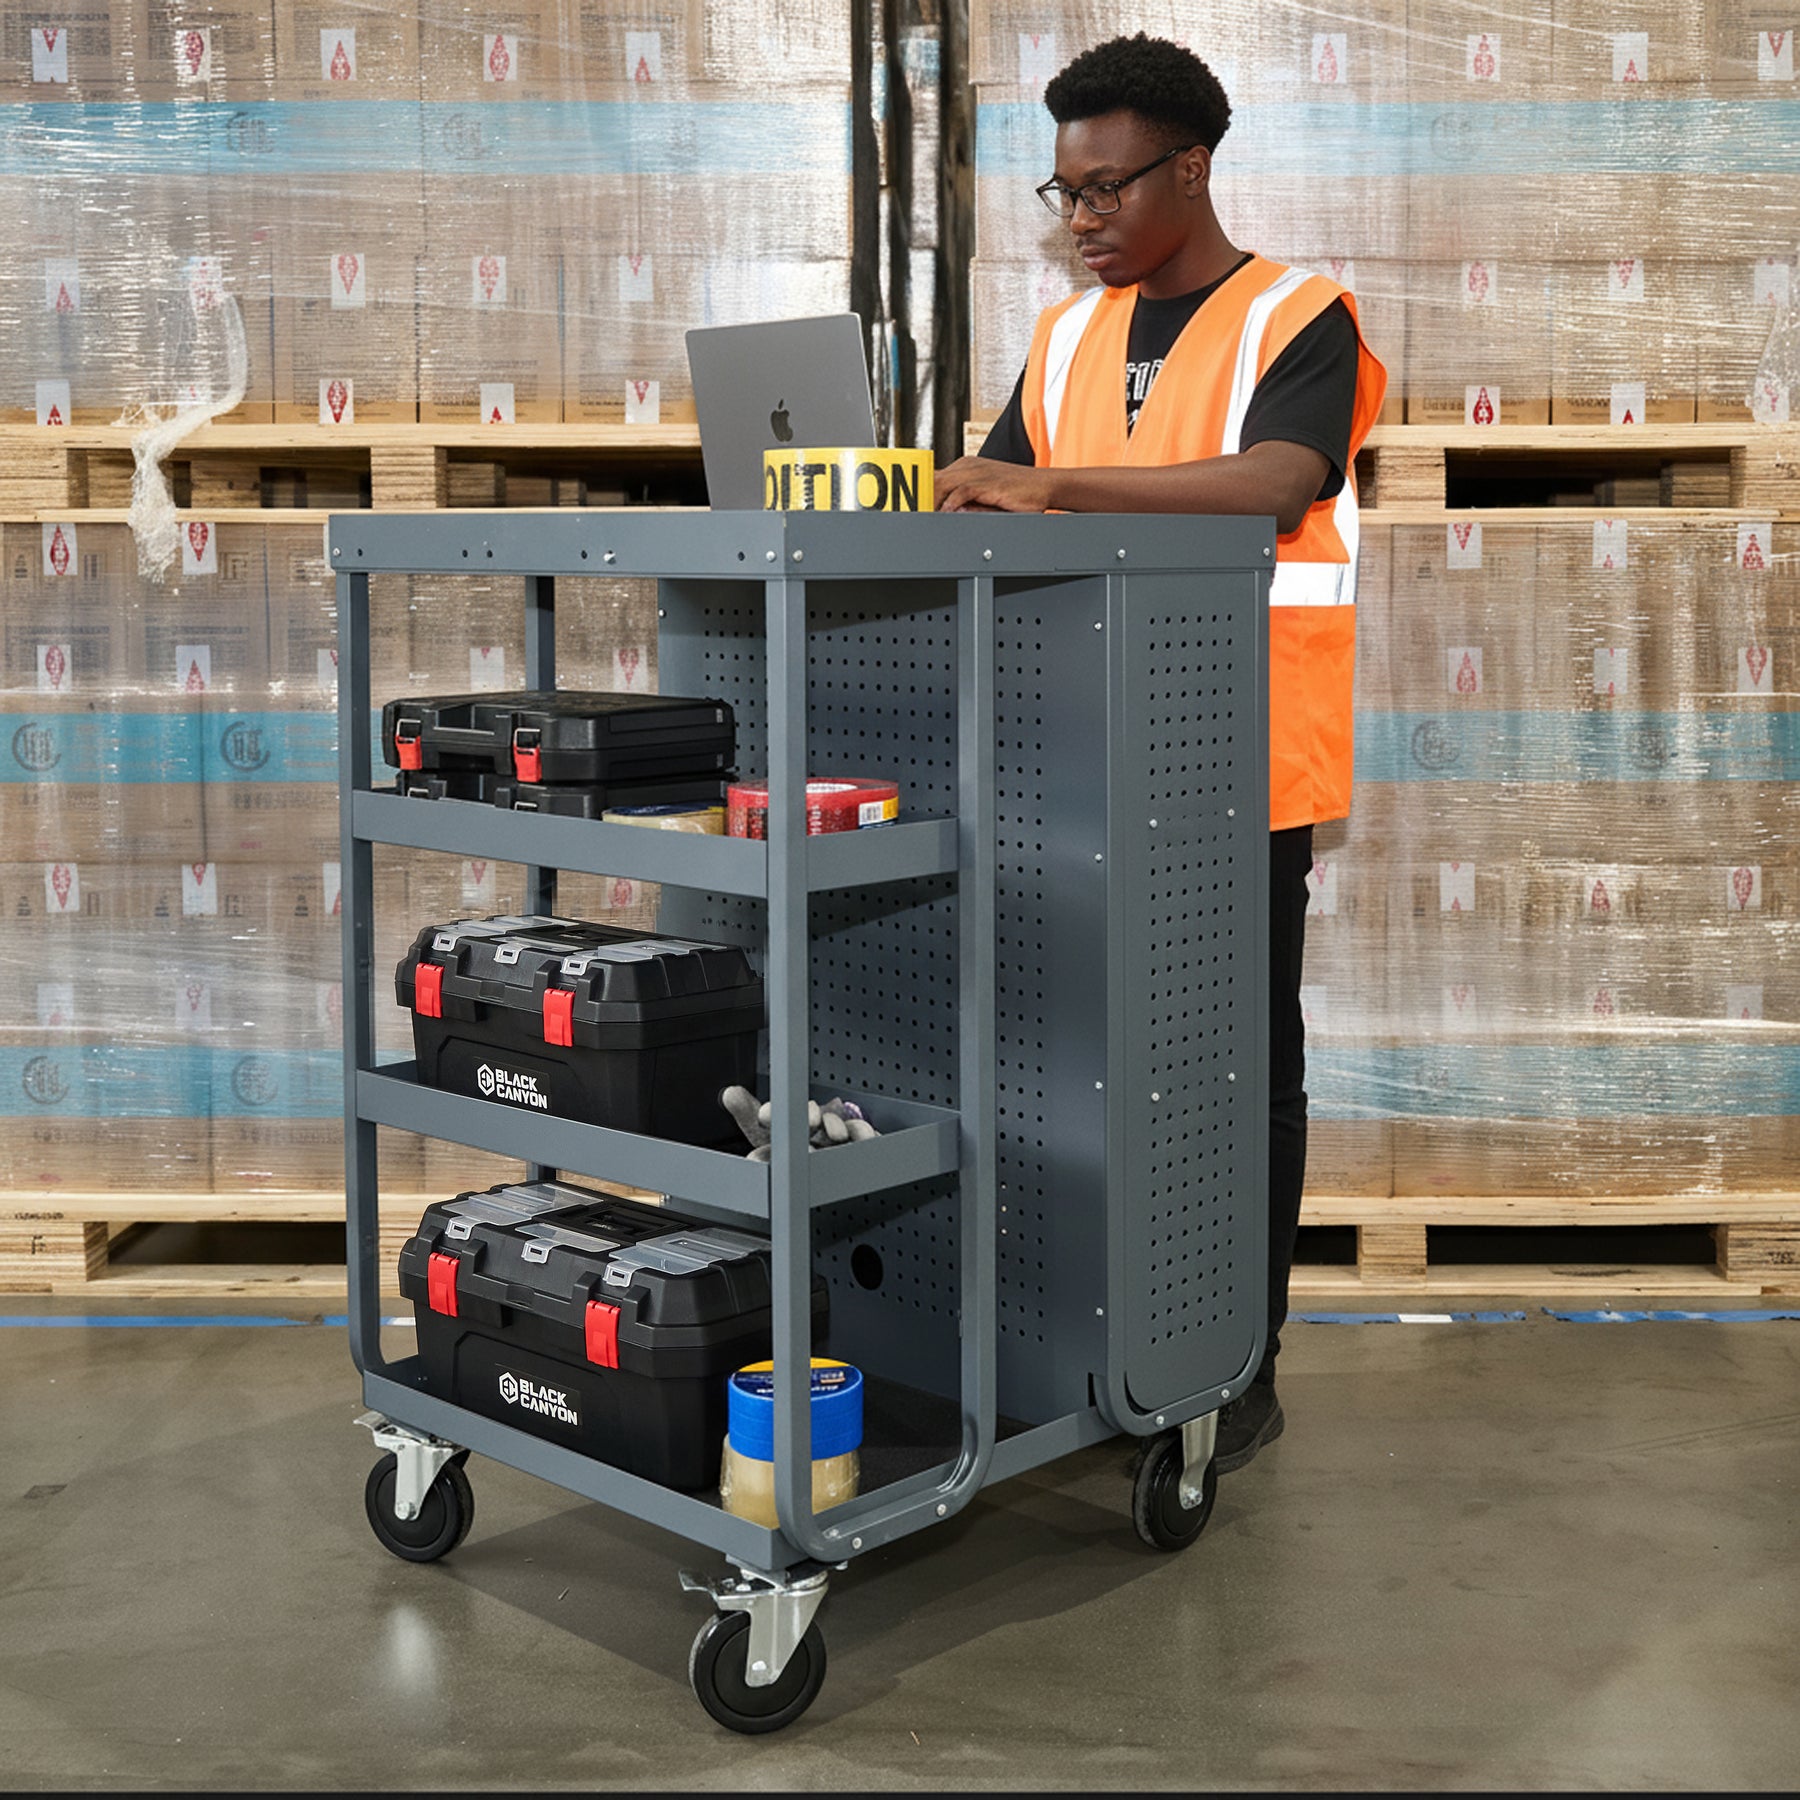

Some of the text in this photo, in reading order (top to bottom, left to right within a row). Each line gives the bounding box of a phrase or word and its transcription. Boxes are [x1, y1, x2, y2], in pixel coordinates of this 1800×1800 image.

[495, 1068, 538, 1092] BLACK
[496, 1083, 548, 1109] CANYON
[519, 1379, 567, 1407] BLACK
[520, 1393, 578, 1426] CANYON
